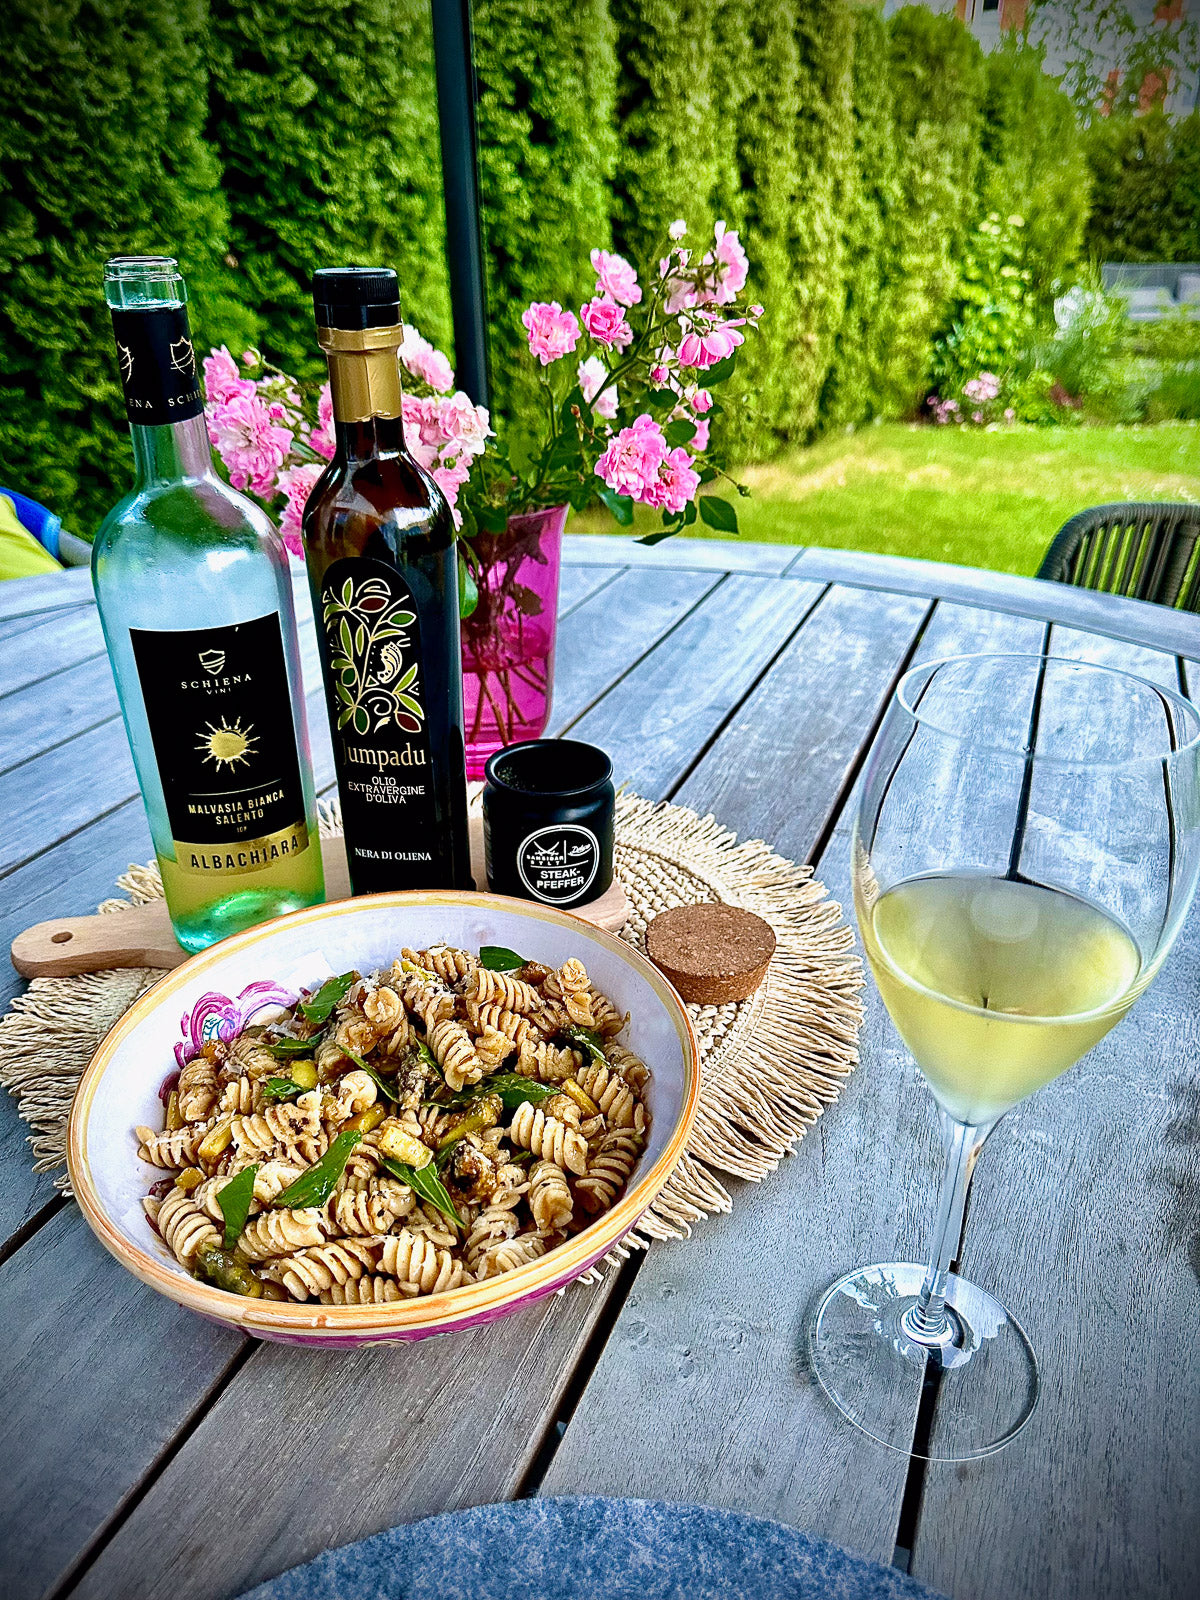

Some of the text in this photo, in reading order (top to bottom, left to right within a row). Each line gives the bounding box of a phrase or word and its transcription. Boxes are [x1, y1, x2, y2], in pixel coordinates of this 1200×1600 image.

[181, 673, 252, 689] SCHIENA
[206, 687, 231, 695] VINI
[348, 781, 425, 795] EXTRAVERGINE
[371, 776, 396, 786] OLIO
[188, 790, 284, 814] MALVASIA BIANCA
[366, 793, 406, 804] D'OLIVA
[215, 809, 264, 825] SALENTO
[190, 834, 299, 870] ALBACHIARA
[355, 847, 432, 861] NERA DI OLIENA
[540, 867, 581, 879] STEAK-
[536, 876, 584, 889] PFEFFER
